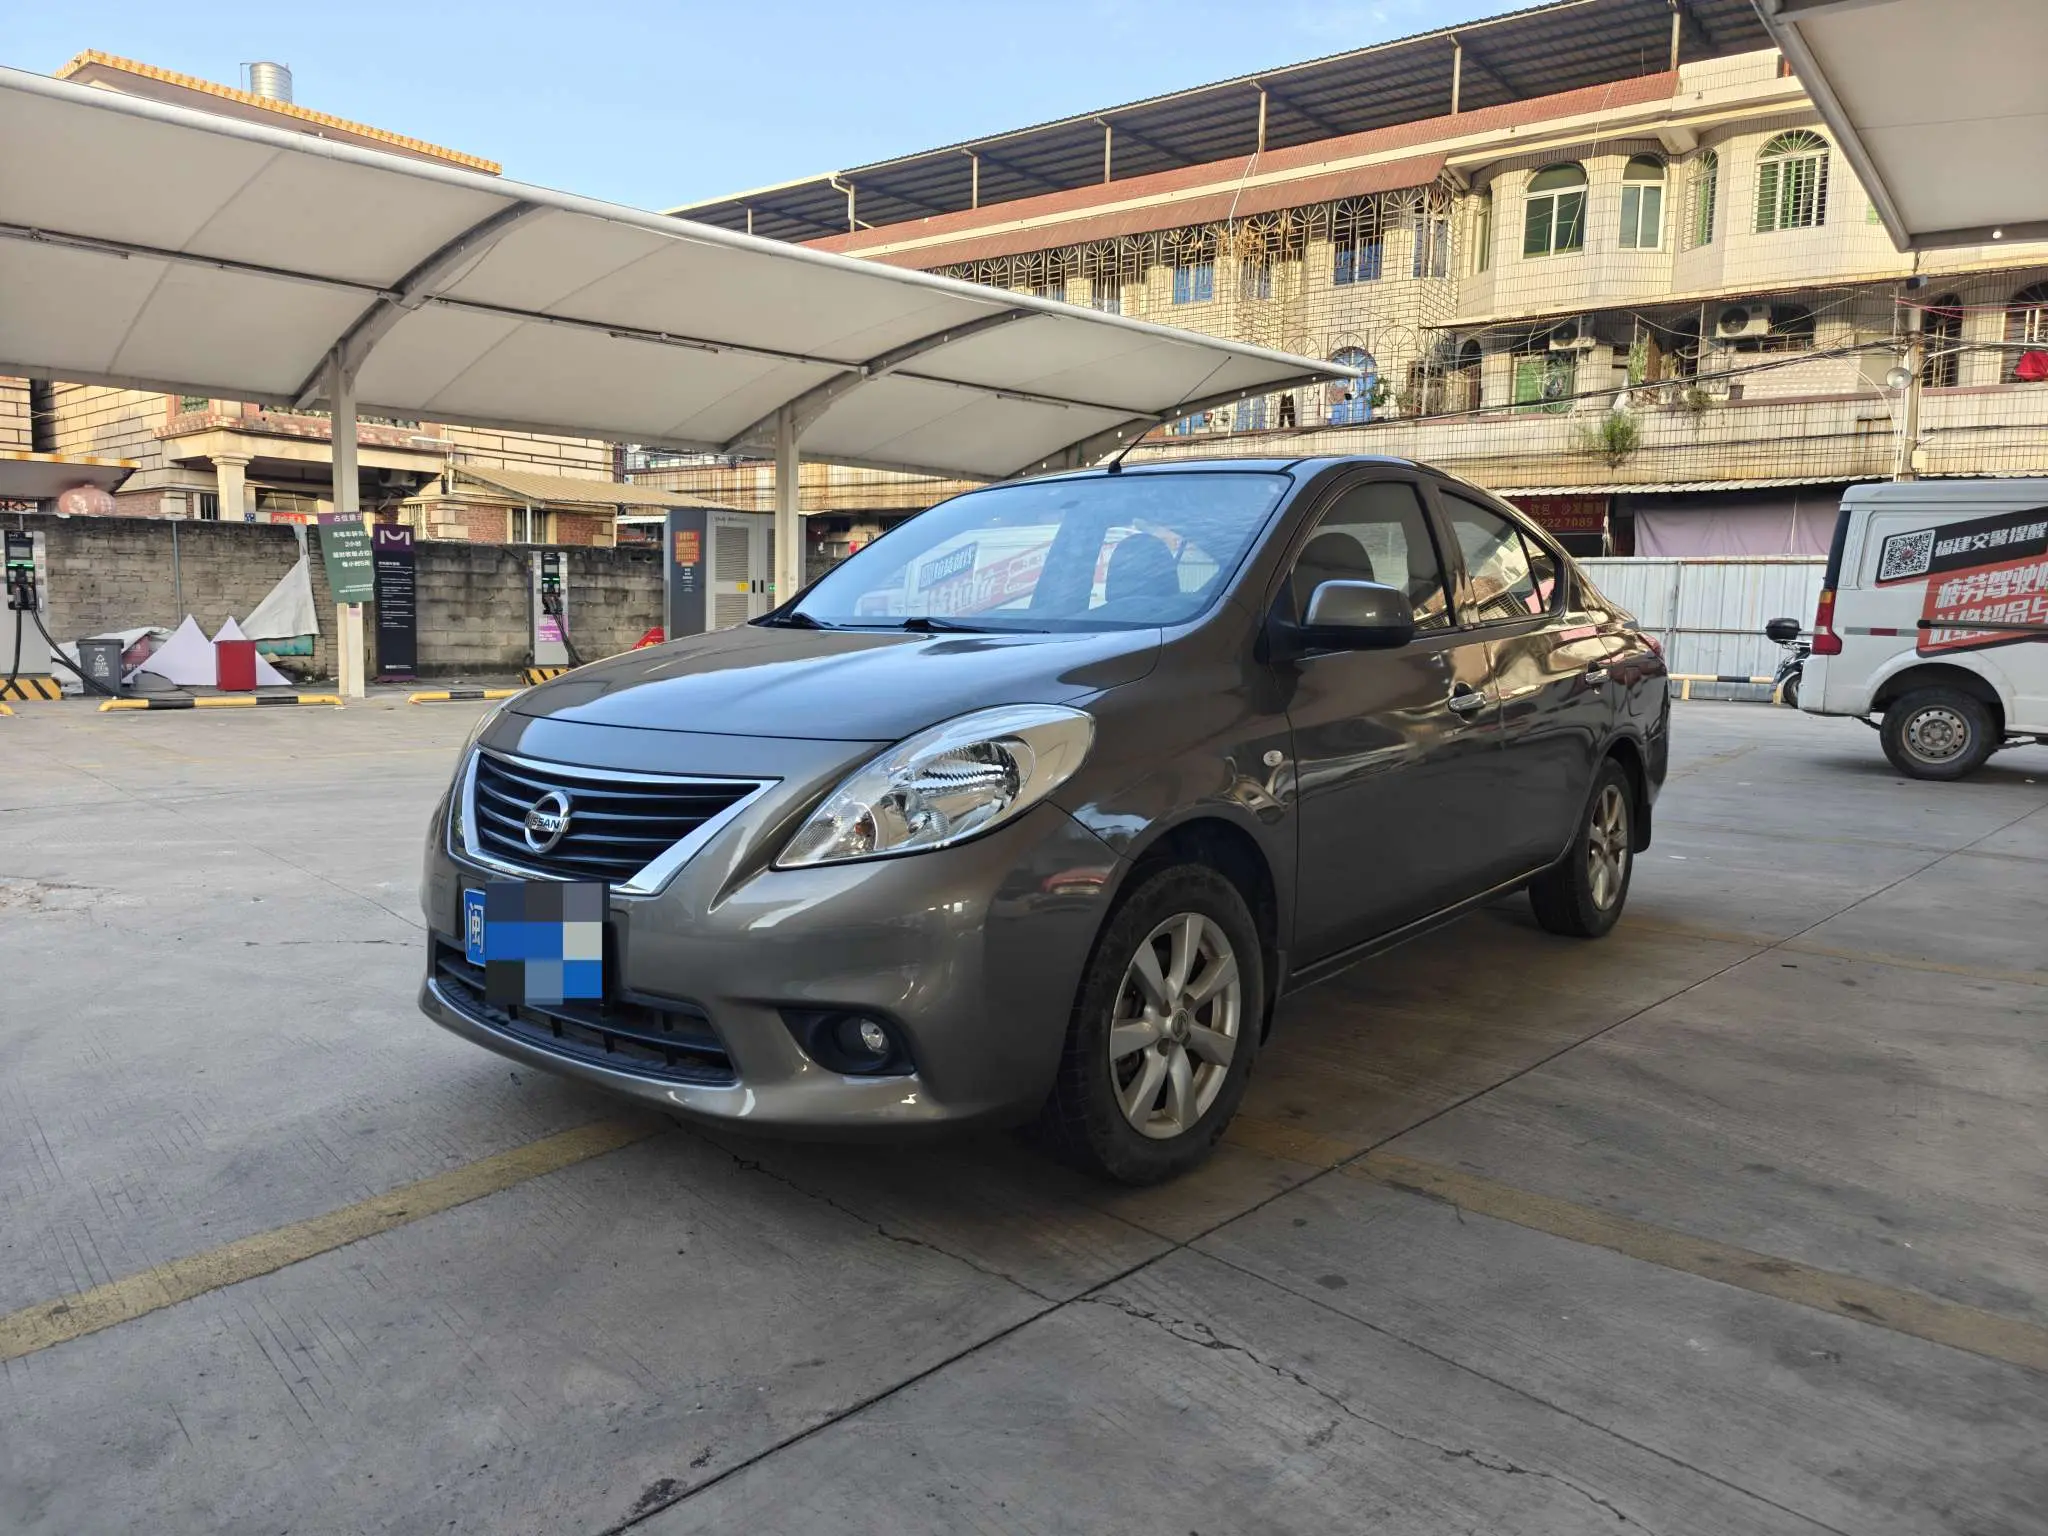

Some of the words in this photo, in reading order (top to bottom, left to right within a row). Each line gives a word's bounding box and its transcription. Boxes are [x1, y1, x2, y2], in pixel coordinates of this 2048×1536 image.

[1564, 517, 1594, 528] 7089
[1935, 521, 2048, 557] 福建交警提醒
[468, 900, 485, 954] 闽
